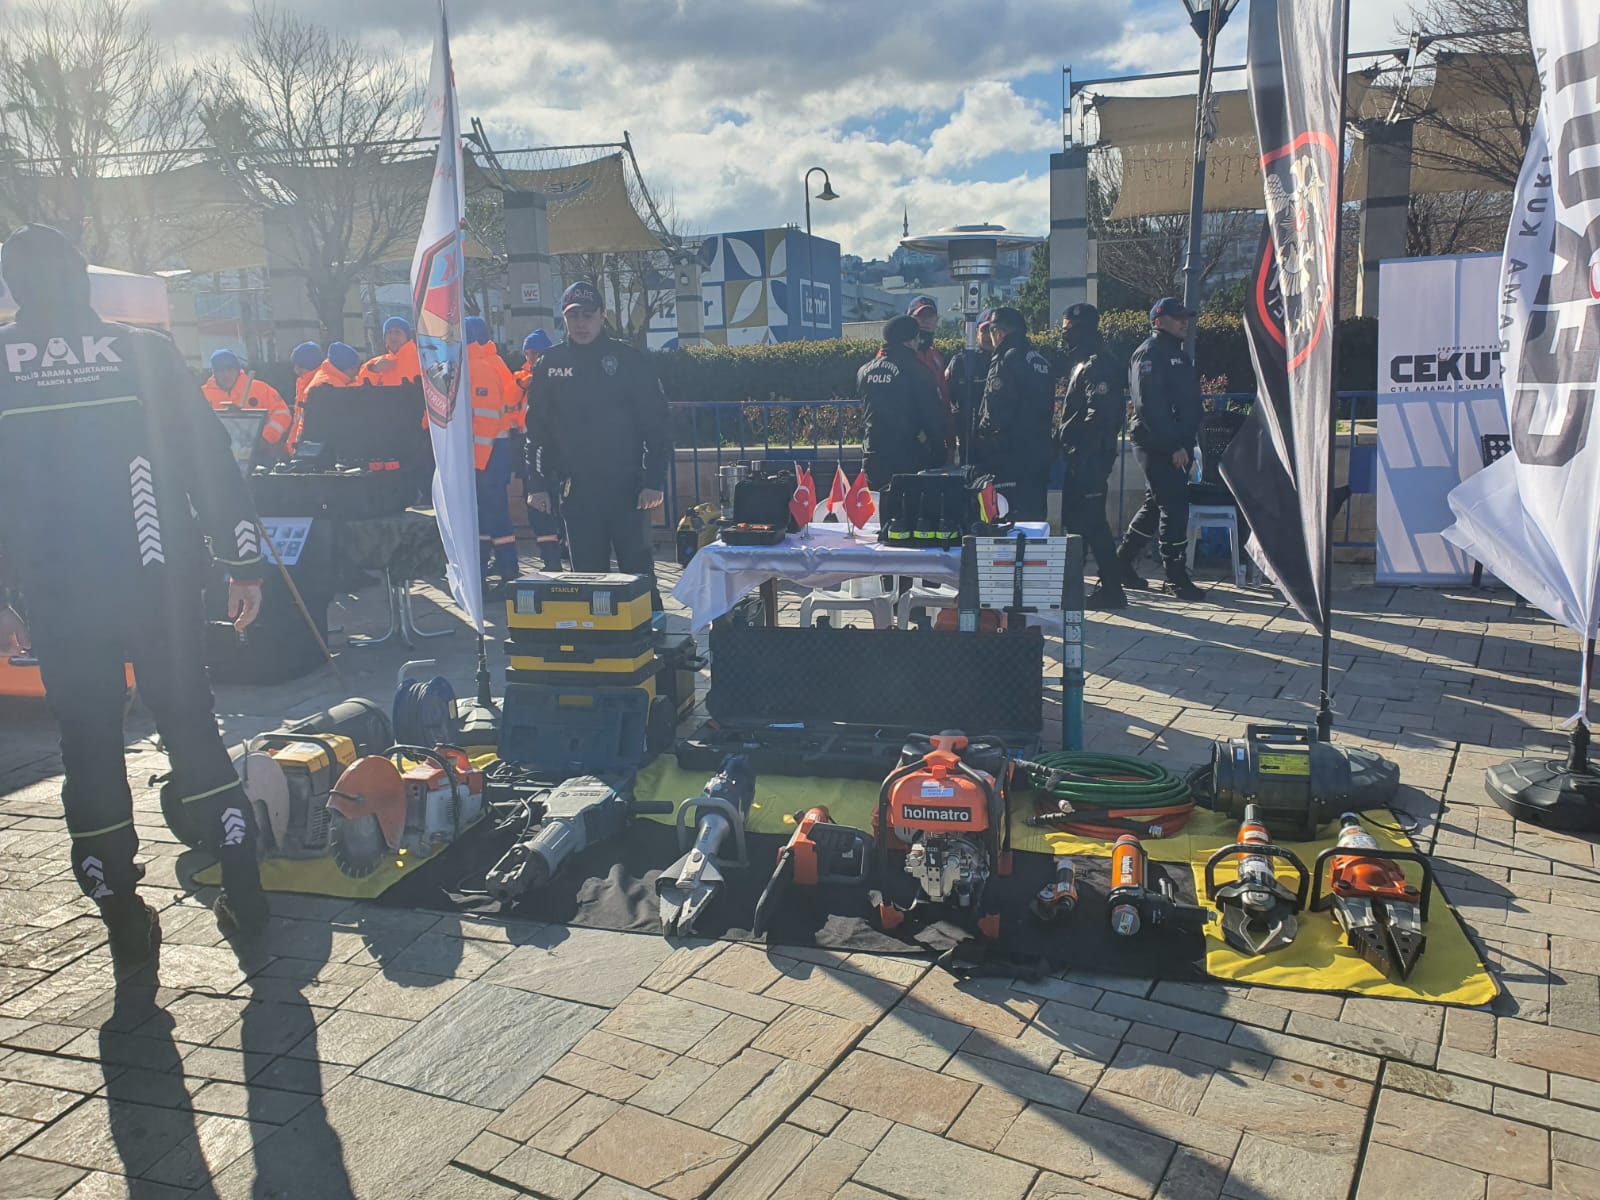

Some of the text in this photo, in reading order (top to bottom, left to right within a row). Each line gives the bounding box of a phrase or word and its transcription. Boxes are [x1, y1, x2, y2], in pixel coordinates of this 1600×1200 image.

[524, 289, 538, 298] WC
[5, 336, 122, 372] PAK
[41, 368, 71, 378] ARAMA
[73, 365, 119, 375] KURTARMA
[548, 367, 573, 377] PAK
[904, 806, 969, 821] holmatro
